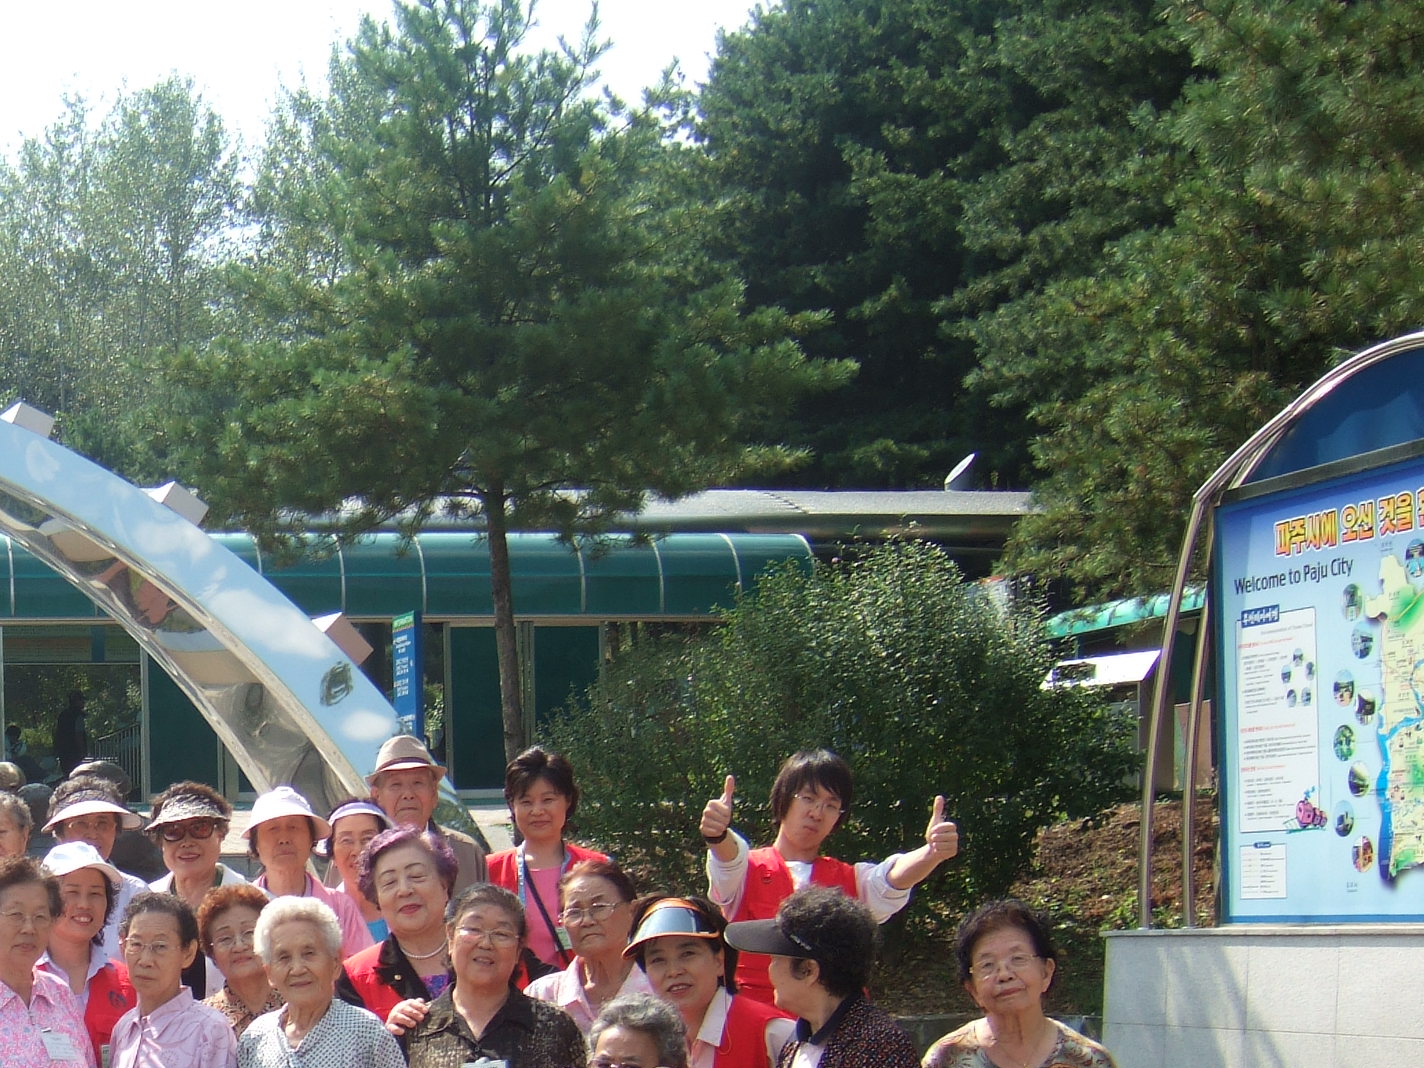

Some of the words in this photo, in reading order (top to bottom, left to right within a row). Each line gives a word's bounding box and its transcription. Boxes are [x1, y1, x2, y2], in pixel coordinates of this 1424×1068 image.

[1275, 510, 1337, 556] 파주시에
[1341, 500, 1375, 543] 오신
[1377, 491, 1414, 536] 것을
[1234, 571, 1287, 595] Welcome
[1289, 569, 1301, 585] to
[1304, 562, 1327, 583] Paju
[1331, 558, 1353, 577] City
